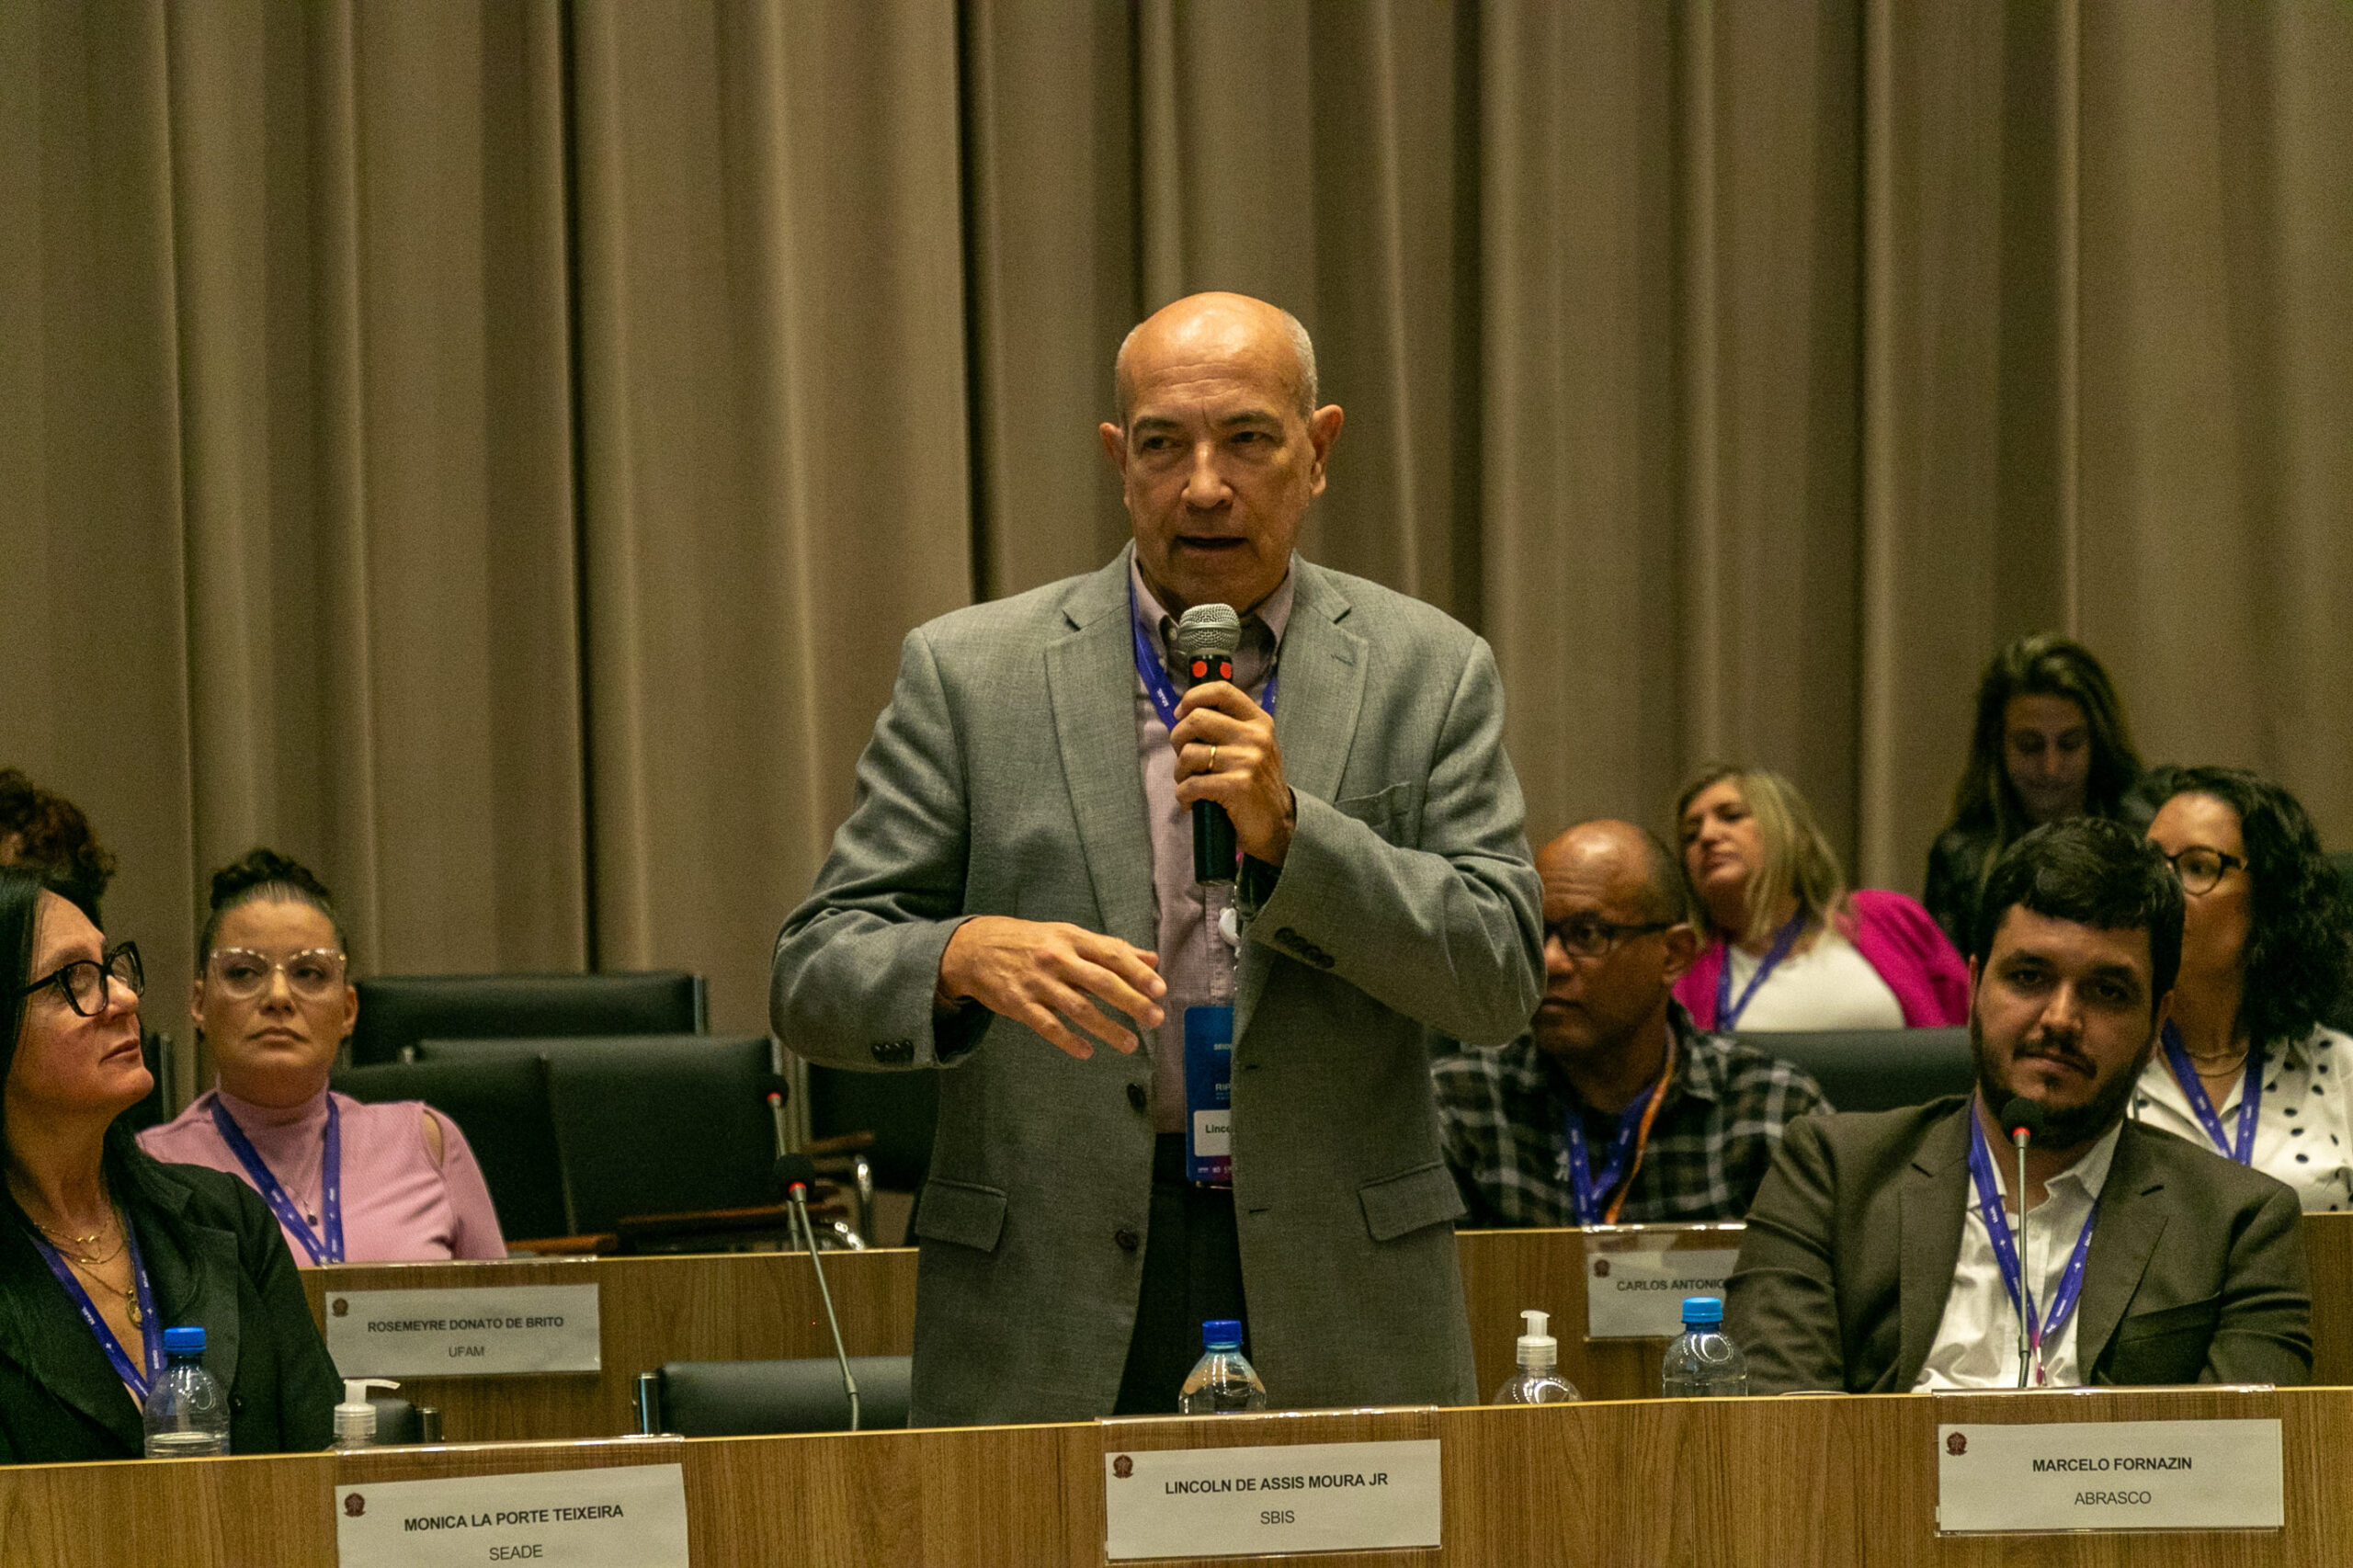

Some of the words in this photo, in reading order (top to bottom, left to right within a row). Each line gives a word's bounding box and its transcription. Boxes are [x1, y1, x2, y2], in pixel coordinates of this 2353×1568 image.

[1617, 1279, 1668, 1291] CARLOS
[367, 1319, 447, 1333] ROSEMEYRE
[449, 1317, 504, 1331] DONATO
[506, 1316, 523, 1329] DE
[525, 1315, 564, 1329] BRITO
[448, 1345, 486, 1358] UFAM
[2032, 1458, 2110, 1472] MARCELO
[2113, 1457, 2193, 1471] FORNAZIN
[1165, 1479, 1233, 1495] LINCOLN
[1235, 1477, 1257, 1493] DE
[1259, 1475, 1305, 1491] ASSIS
[1308, 1473, 1366, 1489] MOURA
[1369, 1471, 1389, 1486] JR
[2074, 1490, 2153, 1506] ABRASCO
[404, 1515, 468, 1532] MONICA
[471, 1513, 493, 1528] LA
[495, 1508, 549, 1526] PORTE
[552, 1504, 624, 1522] TEIXEIRA
[1260, 1509, 1296, 1525] SBIS
[488, 1543, 543, 1562] SEADE
